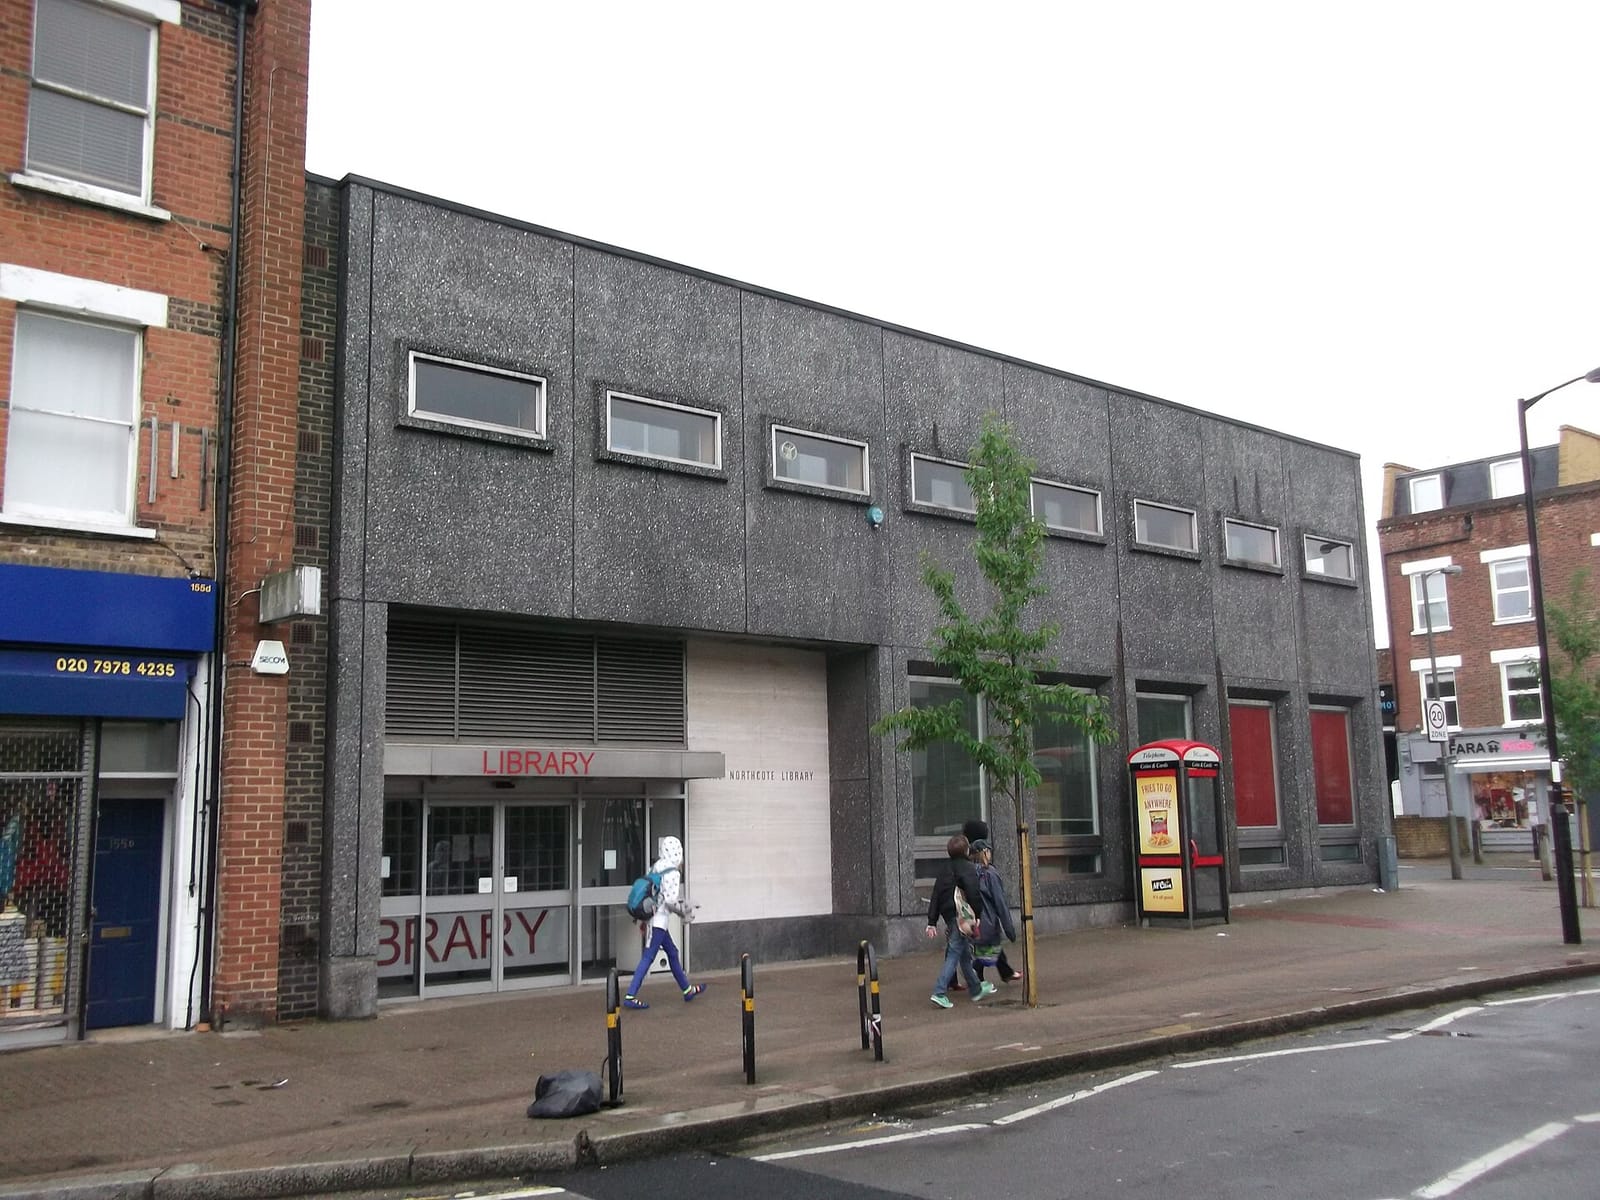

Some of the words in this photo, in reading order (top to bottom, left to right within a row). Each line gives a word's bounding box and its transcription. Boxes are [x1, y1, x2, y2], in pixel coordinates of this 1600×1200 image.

[190, 583, 212, 593] 155d
[259, 655, 286, 664] SECOM
[56, 658, 88, 673] 020
[93, 660, 131, 675] 7978
[136, 662, 175, 677] 4235
[1431, 710, 1443, 722] 20
[1431, 730, 1447, 738] ZONE
[1448, 742, 1486, 755] FARA
[482, 750, 596, 775] LIBRARY
[729, 770, 774, 781] NORTHCOTE
[781, 771, 814, 781] LIBRARY
[1141, 783, 1155, 794] FRIES
[1156, 783, 1164, 792] TO
[1144, 799, 1172, 809] ANYWHERE
